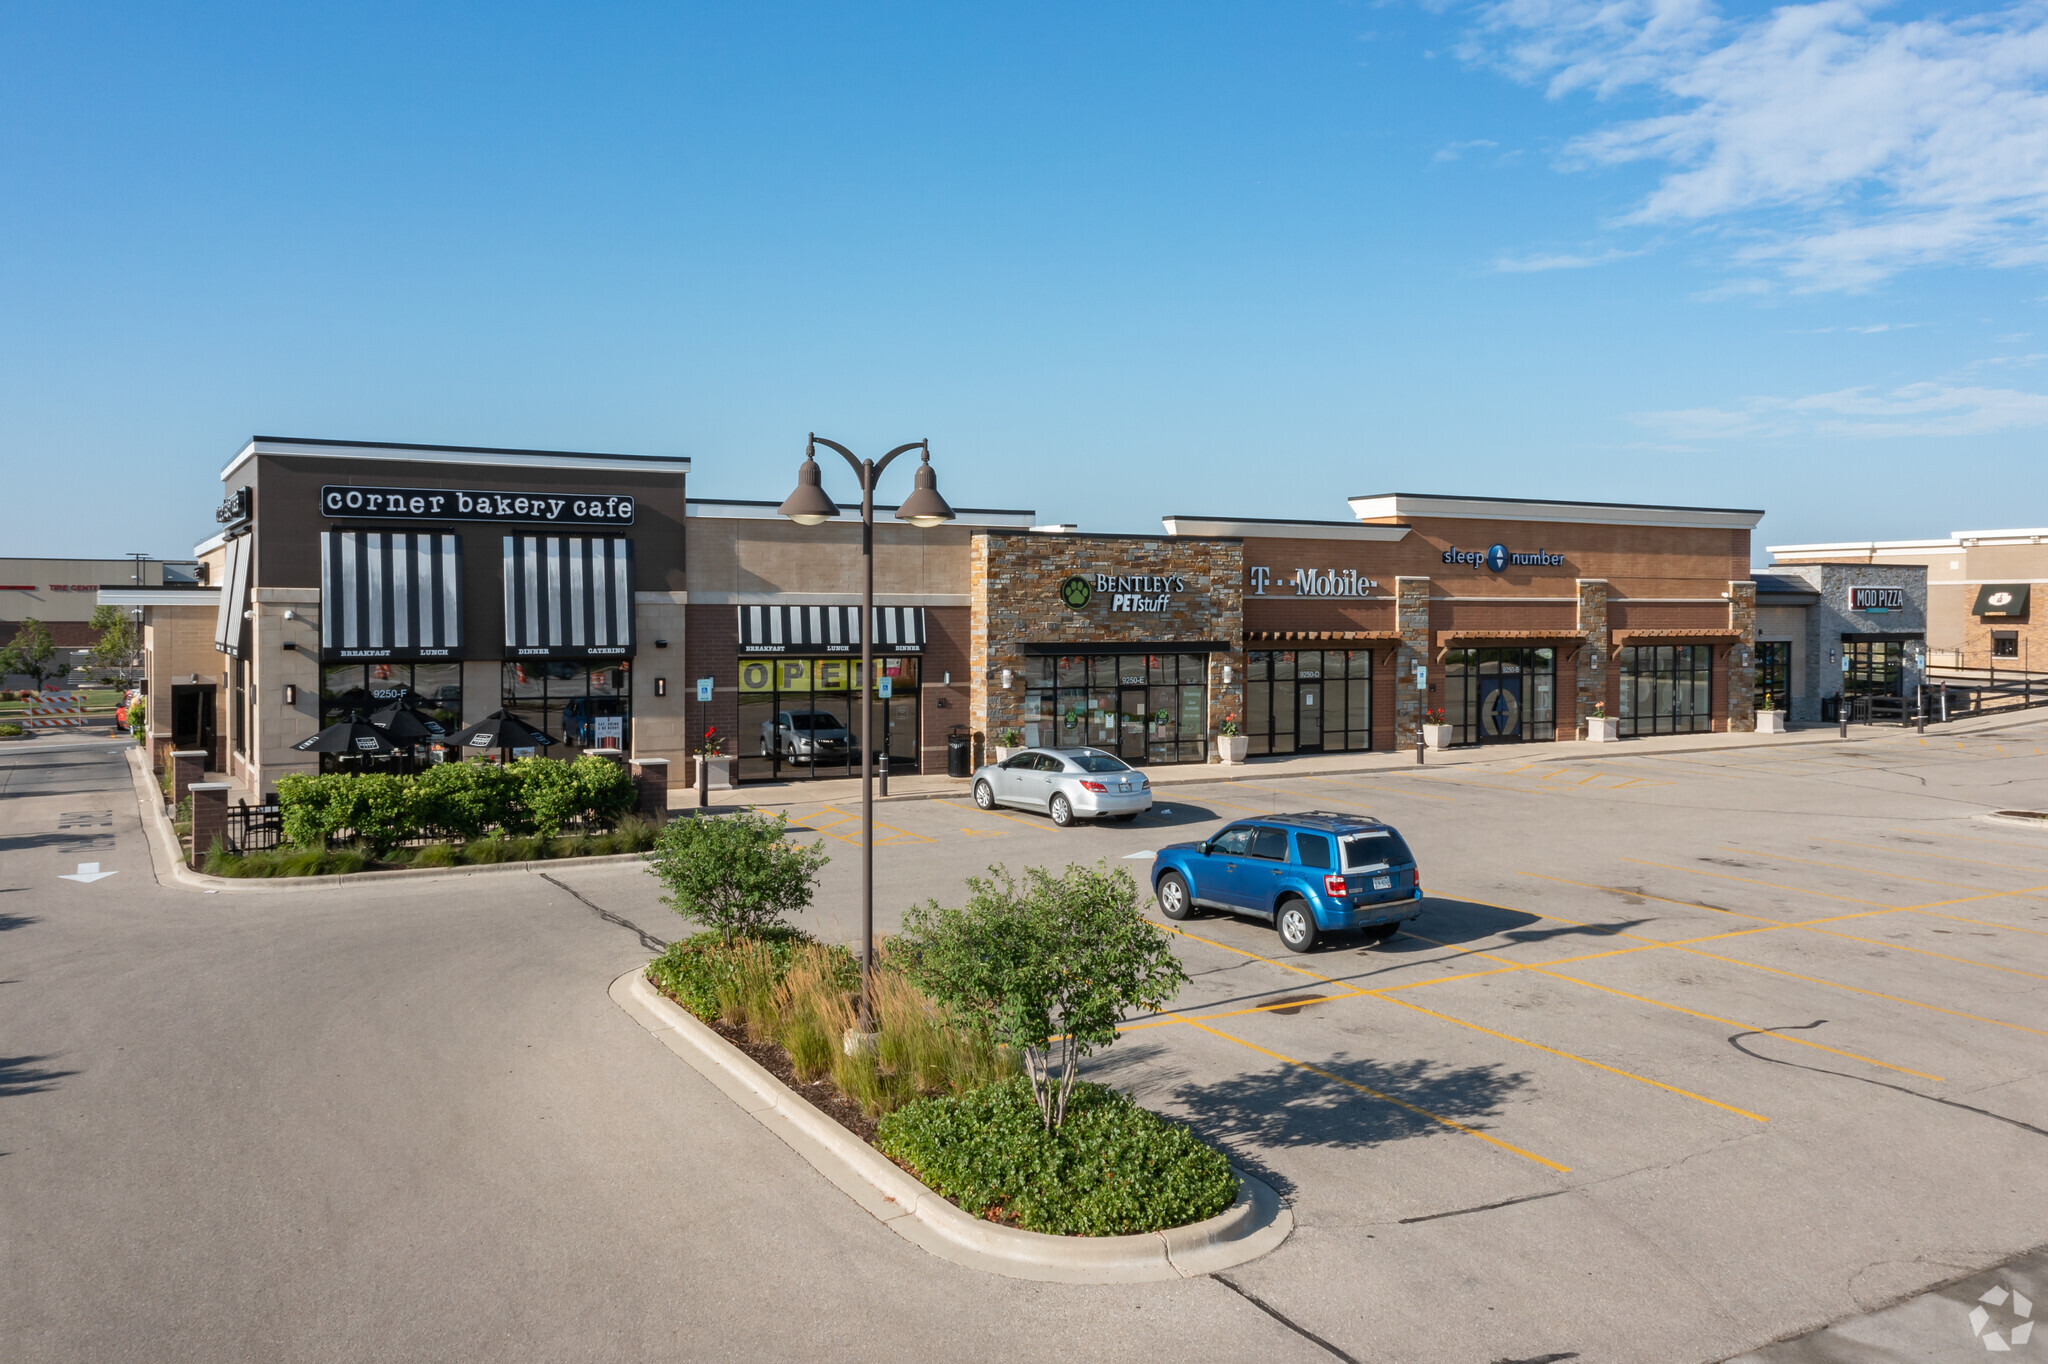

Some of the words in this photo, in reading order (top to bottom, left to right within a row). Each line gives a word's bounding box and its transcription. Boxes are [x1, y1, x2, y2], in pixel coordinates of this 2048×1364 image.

[326, 491, 445, 514] corner
[455, 492, 565, 519] bakery
[573, 497, 632, 518] cafe
[1443, 546, 1485, 569] sleep
[1511, 549, 1565, 566] number
[49, 584, 68, 592] TIRE
[1095, 573, 1184, 593] BENTLEY'S
[1857, 590, 1877, 607] MOD
[1879, 590, 1903, 607] PIZZA
[1122, 676, 1145, 684] 9250-E
[373, 689, 407, 698] 9250-F
